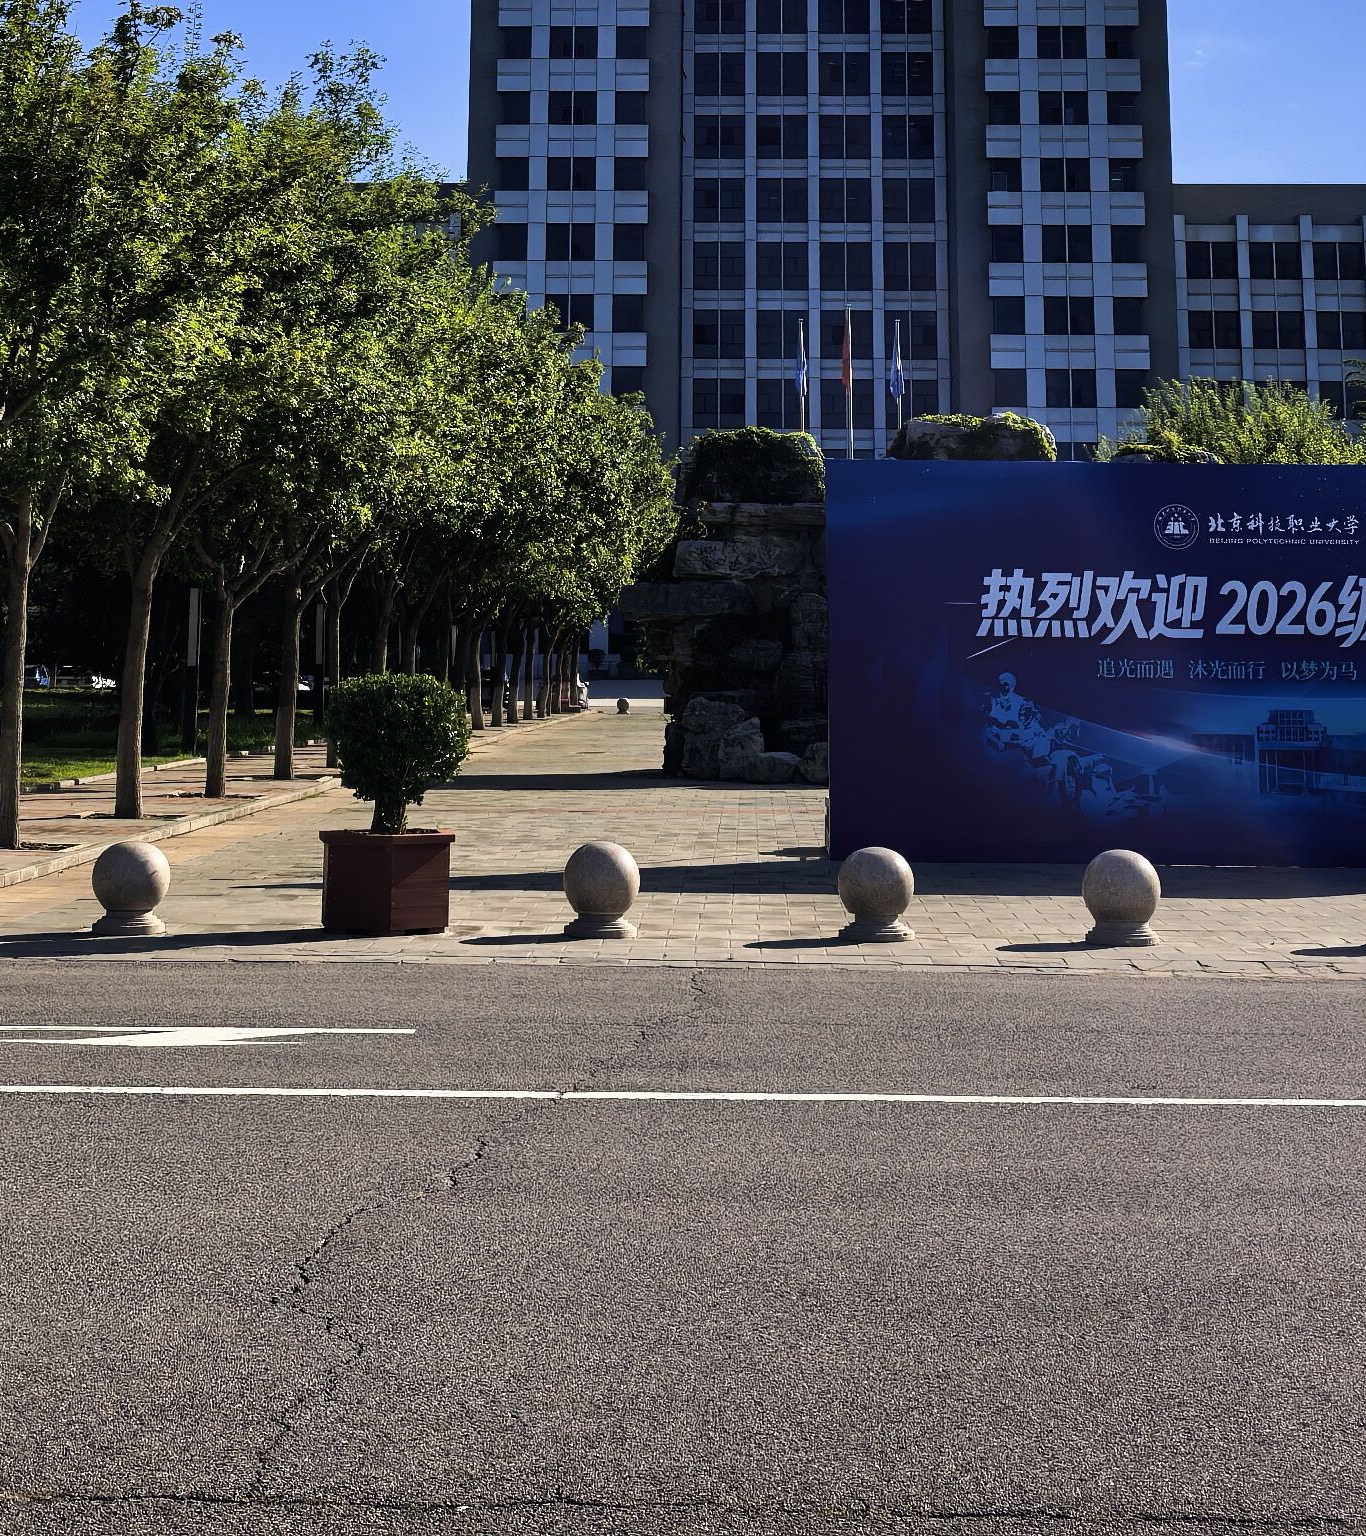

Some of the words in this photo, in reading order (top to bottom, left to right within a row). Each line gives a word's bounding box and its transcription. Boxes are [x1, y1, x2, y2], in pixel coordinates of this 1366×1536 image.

[1208, 512, 1360, 536] 北京科技职业大学
[1309, 538, 1360, 546] UNIVERSITY
[975, 568, 1208, 645] 热烈欢迎
[1097, 658, 1175, 680] 追光而遇
[1188, 658, 1267, 681] 沐光而行
[1281, 659, 1358, 682] 以梦为马
